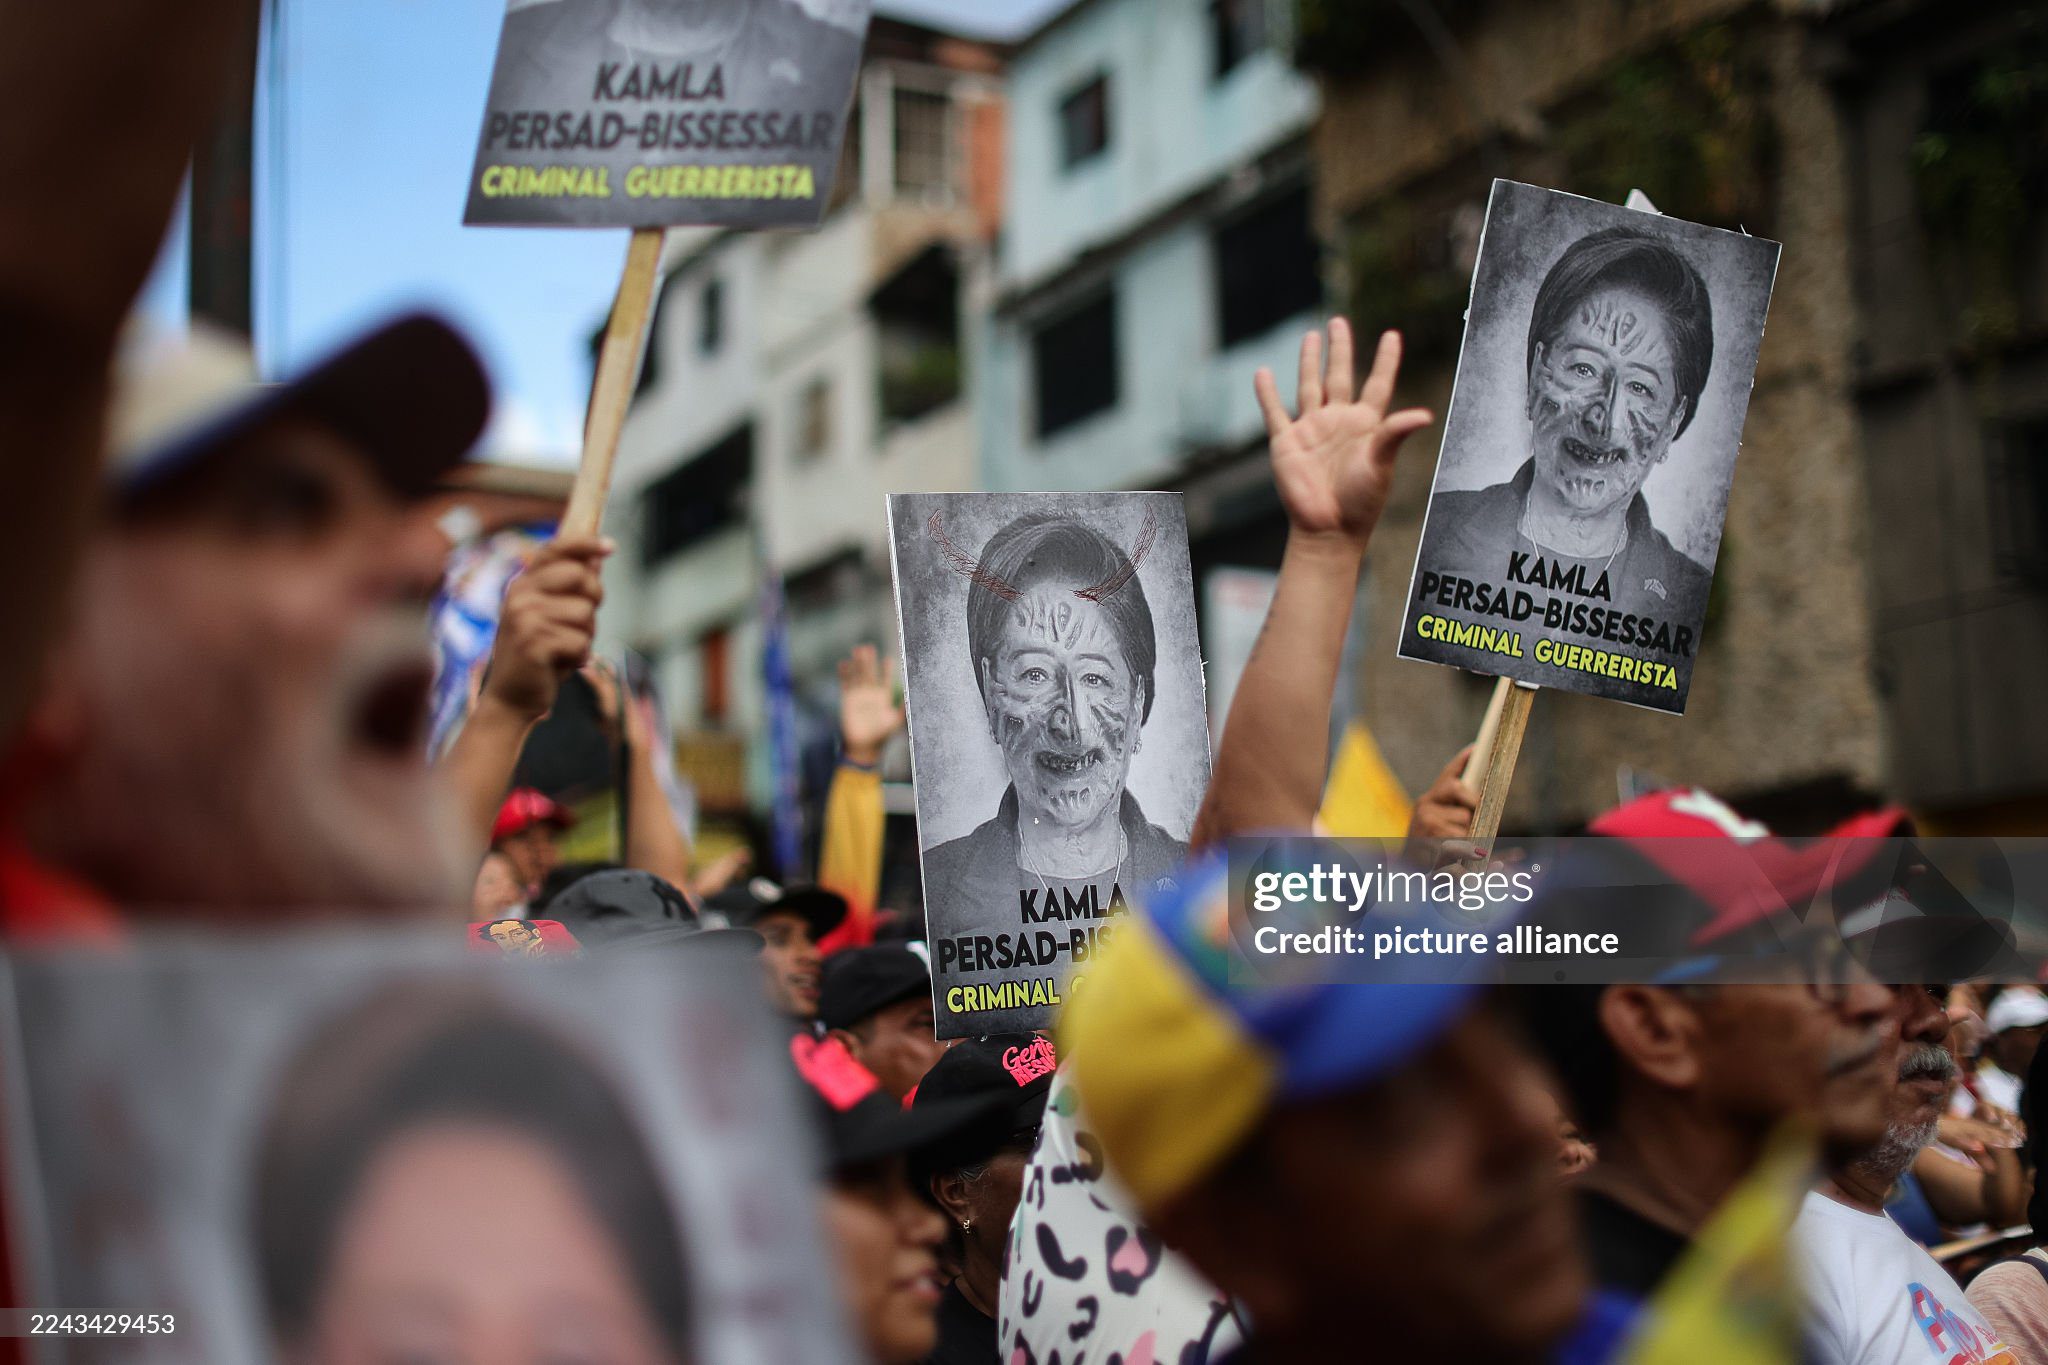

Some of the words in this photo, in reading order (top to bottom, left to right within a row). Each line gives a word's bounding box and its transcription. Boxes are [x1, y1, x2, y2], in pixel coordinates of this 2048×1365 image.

[592, 62, 726, 101] KAMLA
[484, 110, 834, 151] PERSAD-BISSESSAR
[480, 165, 611, 199] CRIMINAL
[625, 164, 815, 199] GUERRERISTA
[1507, 550, 1612, 602] KAMLA
[1418, 571, 1694, 658] PERSAD-BISSESSAR
[1416, 614, 1524, 658] CRIMINAL
[1534, 638, 1678, 691] GUERRERISTA
[1019, 882, 1131, 924] KAMLA
[946, 978, 1061, 1014] CRIMINAL
